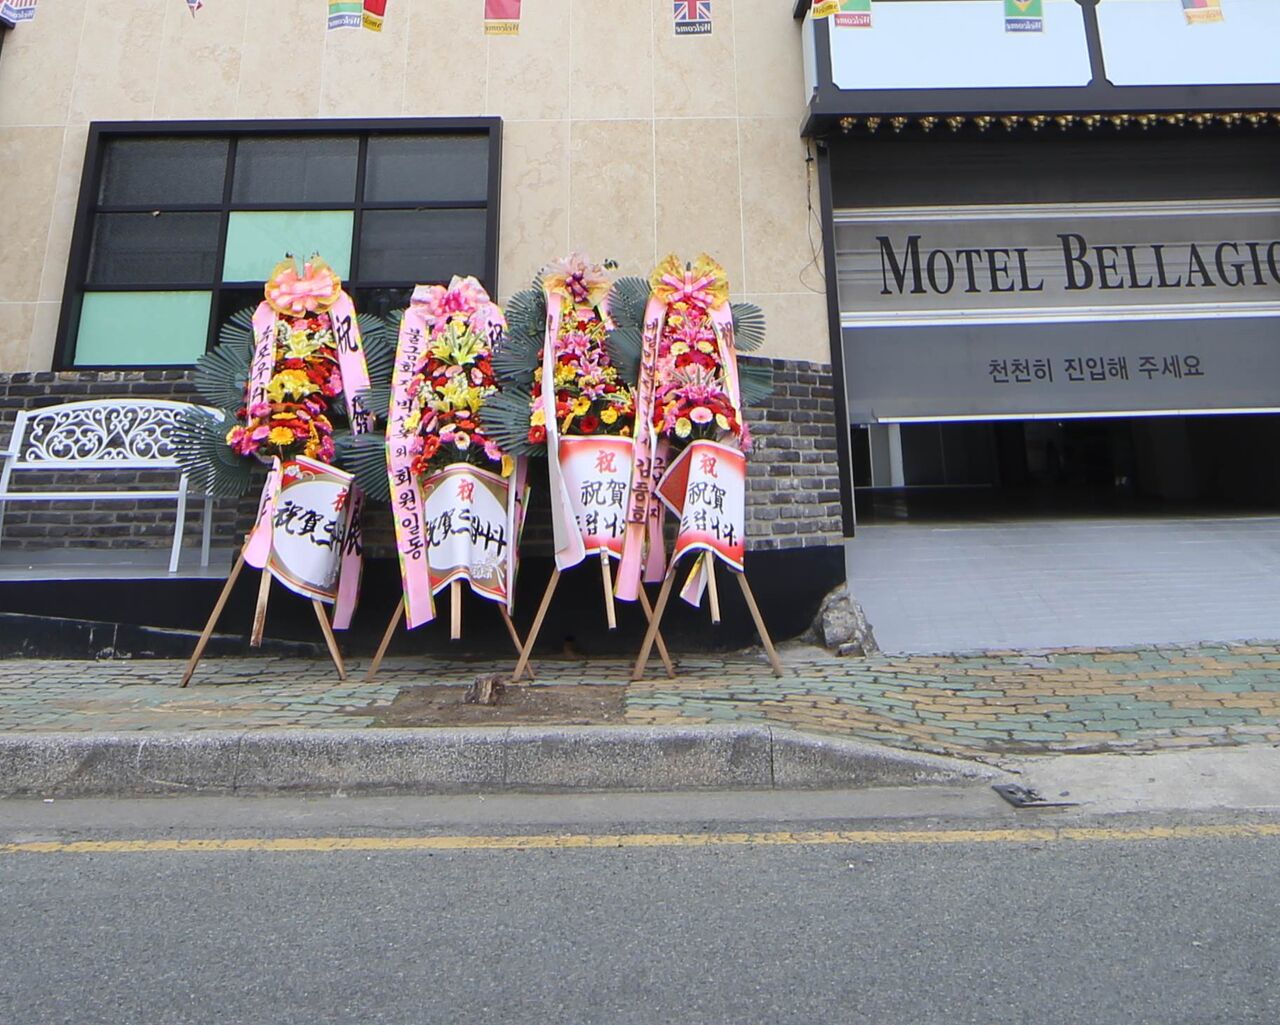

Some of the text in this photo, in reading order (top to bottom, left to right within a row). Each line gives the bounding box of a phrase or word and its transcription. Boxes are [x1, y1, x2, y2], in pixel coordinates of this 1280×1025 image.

[875, 234, 1044, 295] MOTEL
[988, 353, 1205, 384] 천천히 진입해 주세요
[594, 450, 617, 474] 祝
[699, 453, 719, 478] 祝
[580, 479, 627, 509] 祝賀
[688, 481, 727, 515] 祝賀
[395, 466, 427, 560] 회원일동
